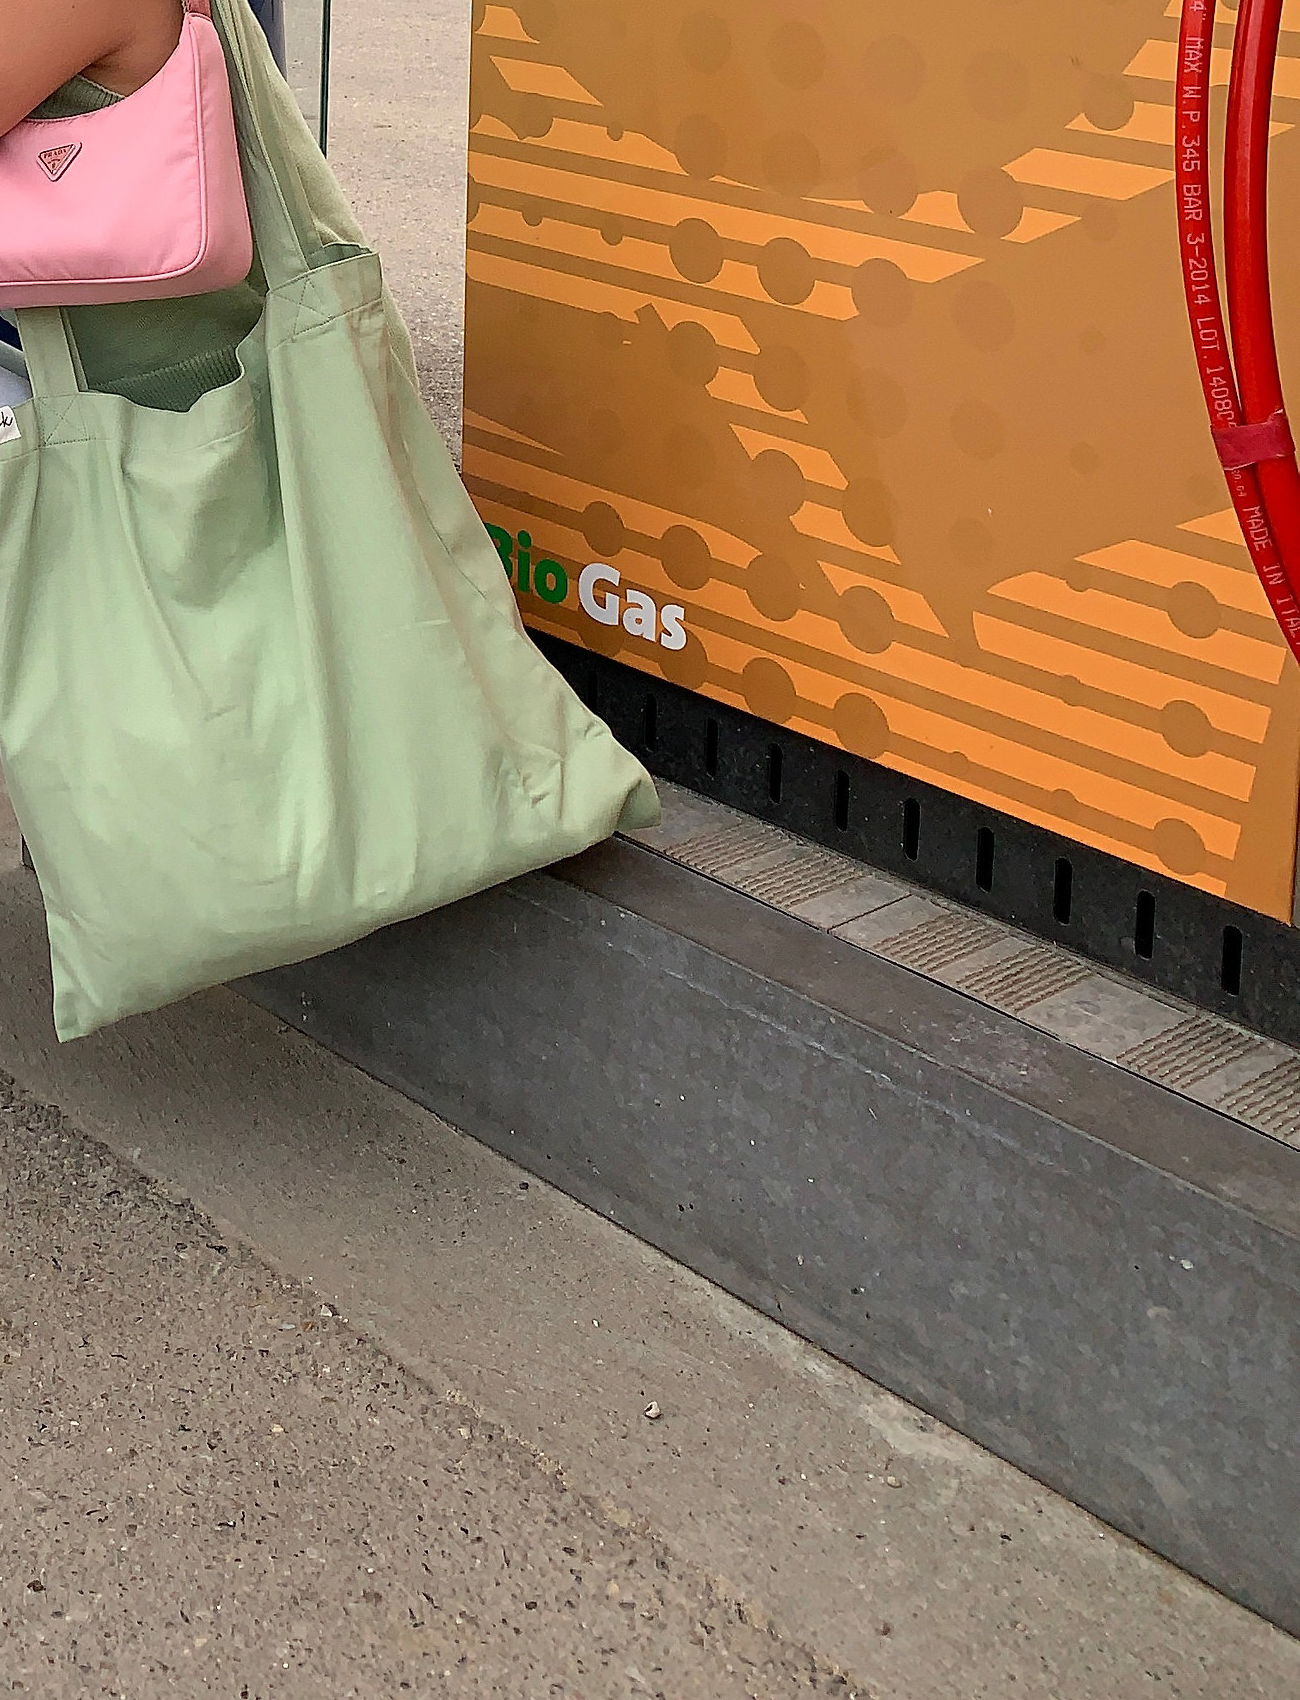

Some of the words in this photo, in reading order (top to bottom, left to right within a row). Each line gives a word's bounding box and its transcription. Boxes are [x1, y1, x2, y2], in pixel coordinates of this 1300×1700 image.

[1183, 36, 1204, 74] MAX
[1182, 185, 1203, 222] BAR
[1187, 233, 1211, 305] 3-2014
[1243, 505, 1273, 551] MADE
[1263, 563, 1284, 586] IN
[1276, 595, 1300, 645] ITAL
